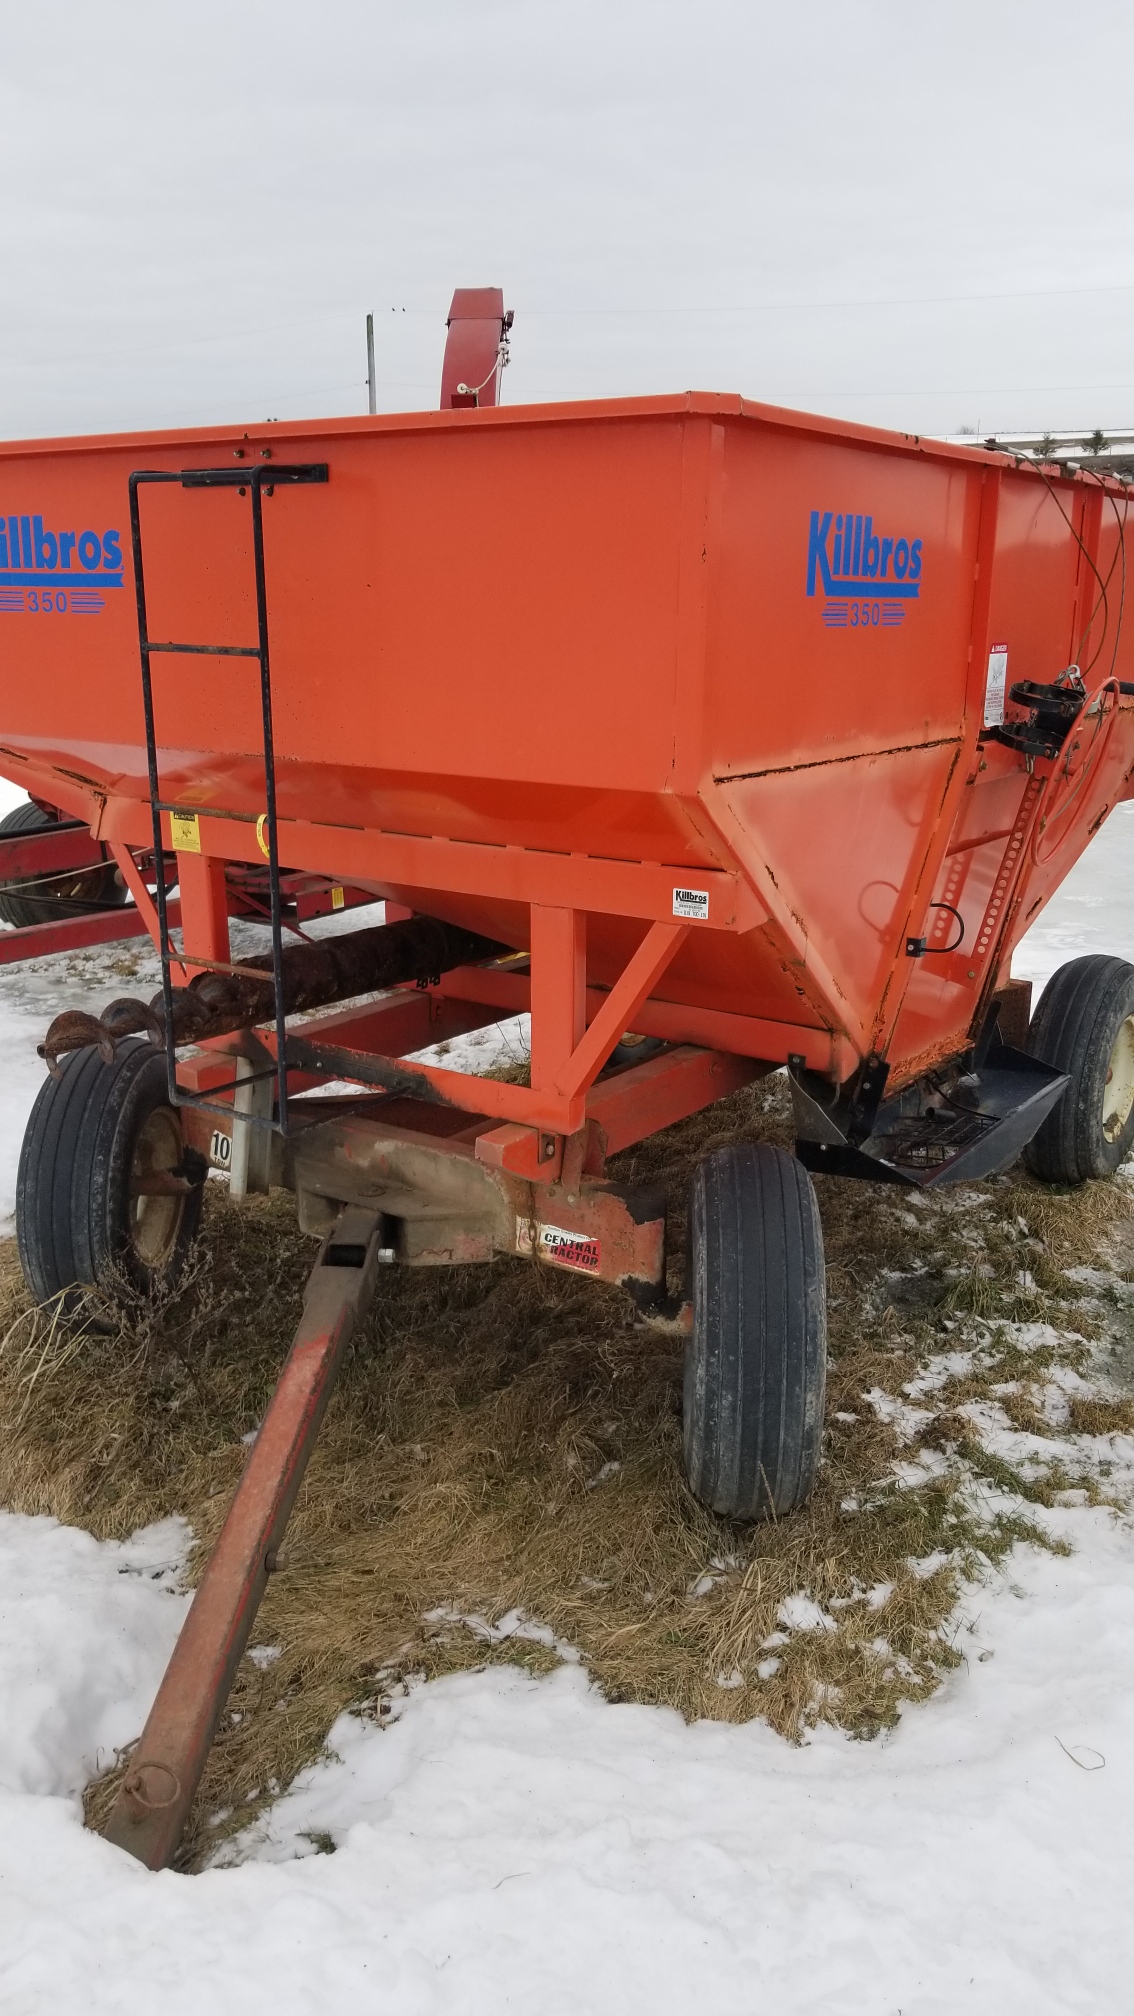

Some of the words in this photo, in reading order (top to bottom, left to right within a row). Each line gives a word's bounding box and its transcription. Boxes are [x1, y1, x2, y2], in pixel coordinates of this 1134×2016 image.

[0, 514, 123, 571] illbros
[805, 510, 922, 597] Killbros
[27, 591, 67, 613] 350
[850, 602, 880, 627] 350
[675, 890, 707, 902] Killbros
[212, 1133, 230, 1160] 10
[544, 1233, 598, 1257] CENTRAL
